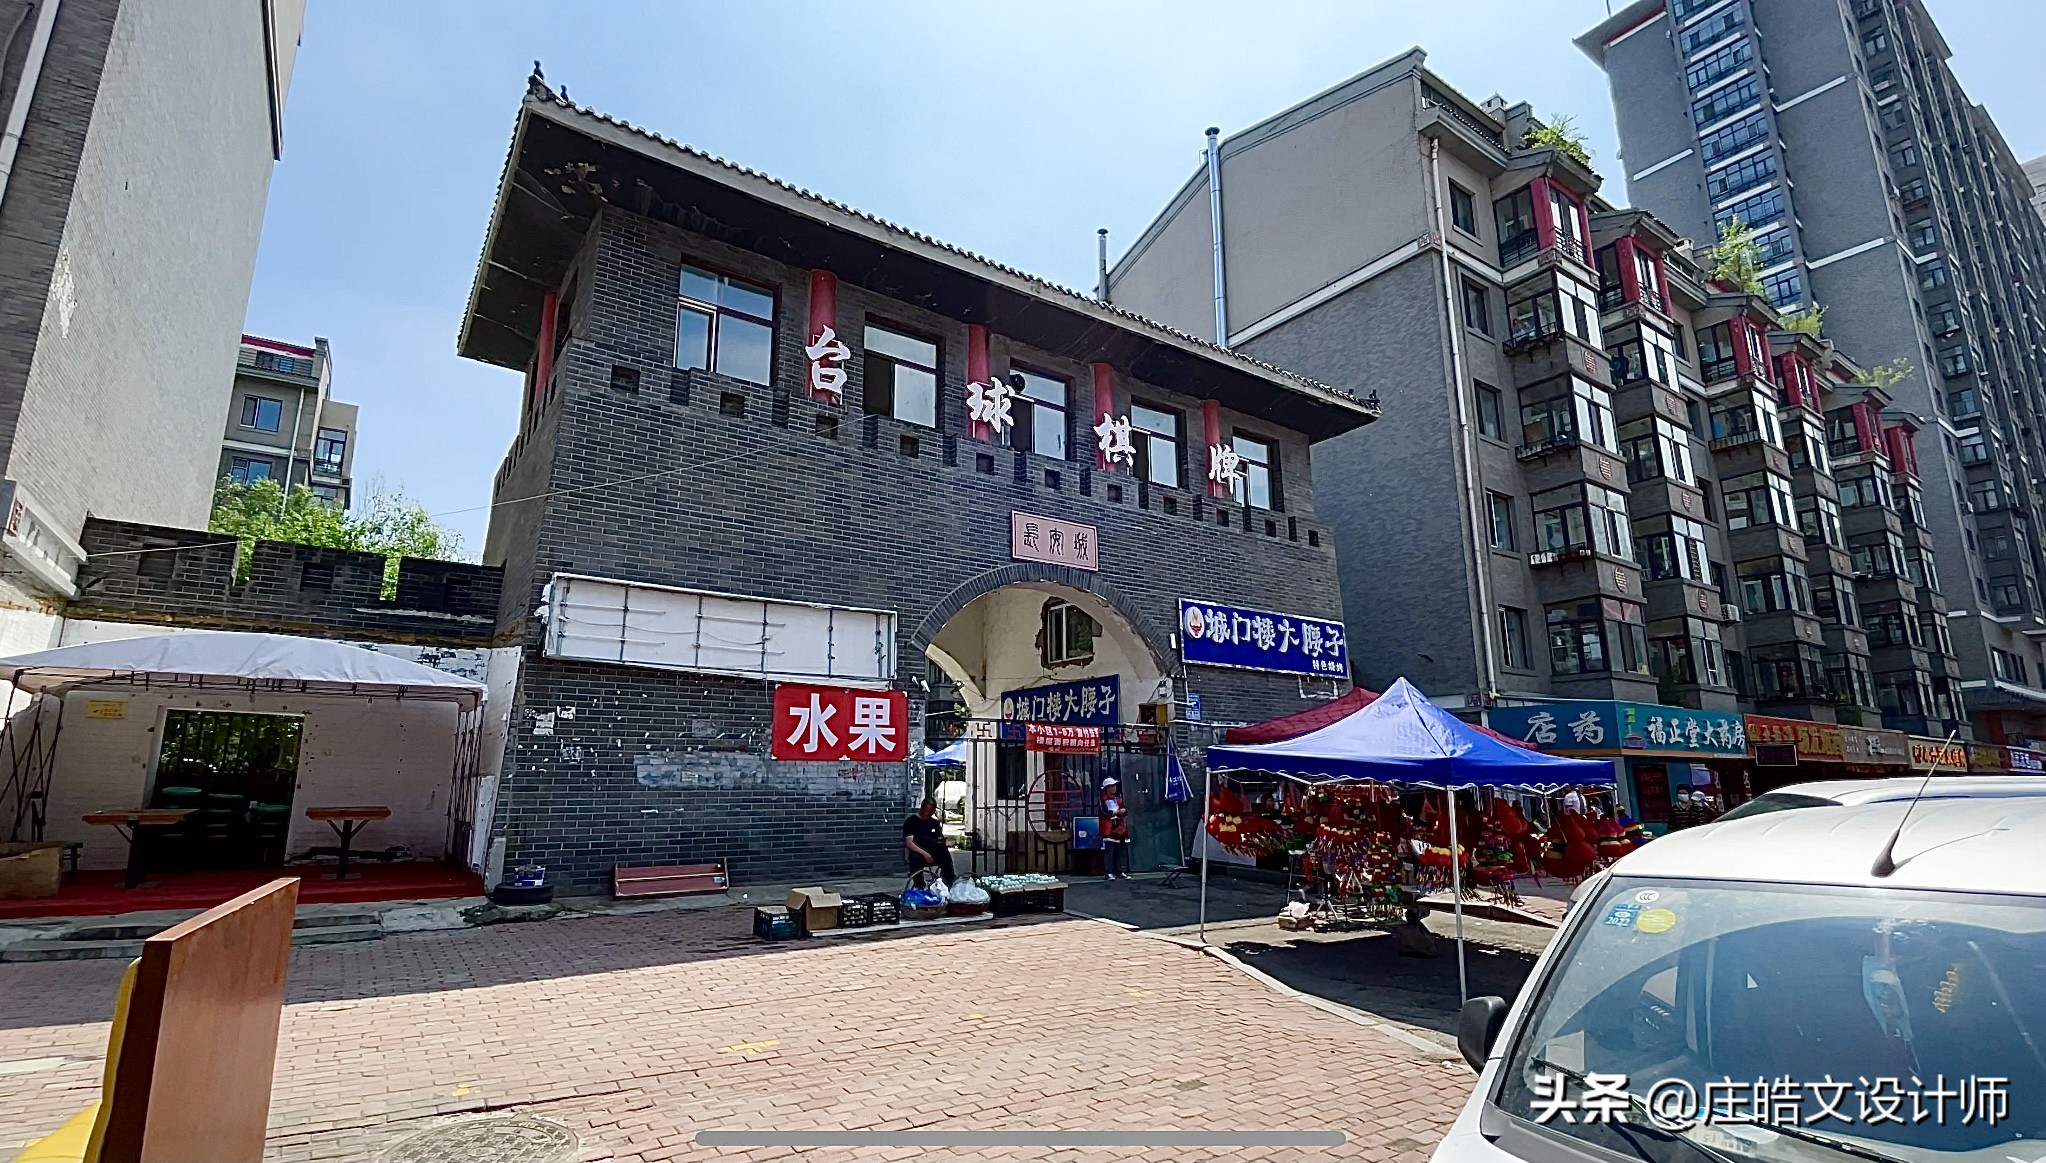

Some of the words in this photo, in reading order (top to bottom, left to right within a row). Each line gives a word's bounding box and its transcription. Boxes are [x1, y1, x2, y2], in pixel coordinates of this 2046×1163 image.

[805, 325, 1240, 494] 台球棋牌
[1204, 608, 1344, 658] 城门楼大腰子
[1312, 659, 1344, 674] 特色烧烤
[786, 692, 898, 753] 水果
[1016, 685, 1116, 722] 城门楼大腰子
[1647, 716, 1746, 750] 福正堂大药房
